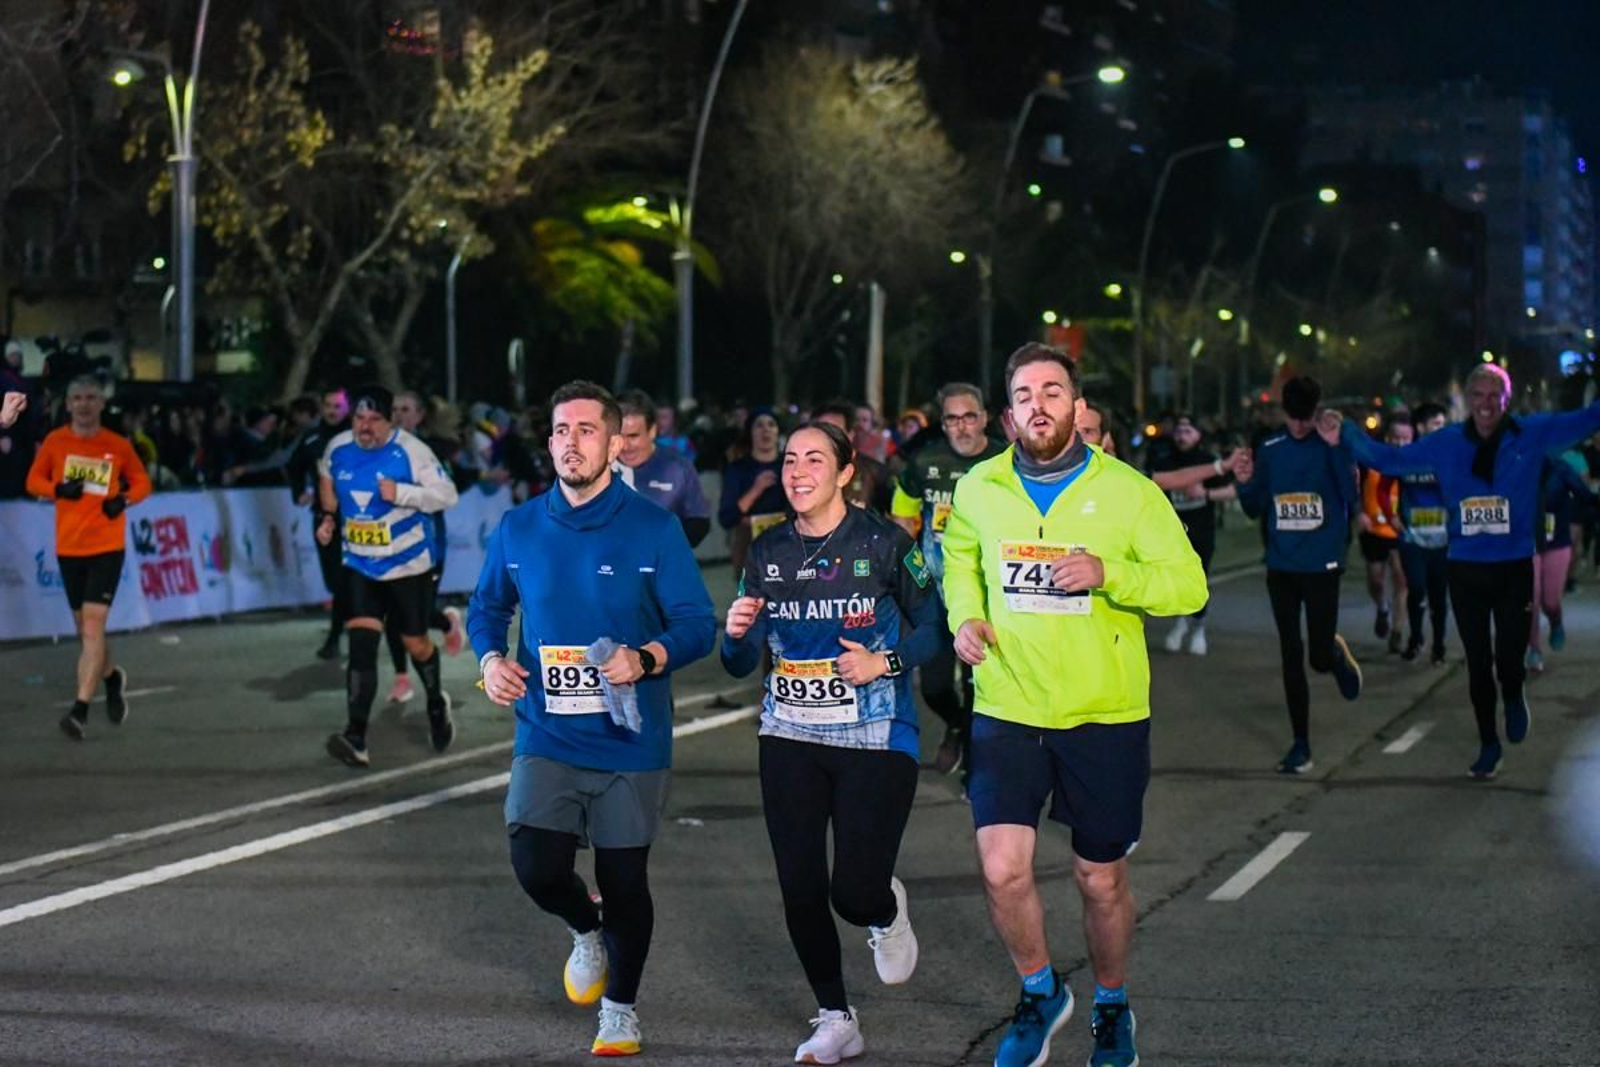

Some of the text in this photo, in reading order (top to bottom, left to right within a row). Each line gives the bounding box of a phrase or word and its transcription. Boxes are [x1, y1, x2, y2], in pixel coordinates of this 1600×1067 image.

[925, 488, 952, 505] SAN
[1280, 503, 1318, 517] 8383
[1465, 507, 1506, 521] 8288
[767, 592, 876, 620] SAN ANTÓN
[776, 676, 846, 700] 8936
